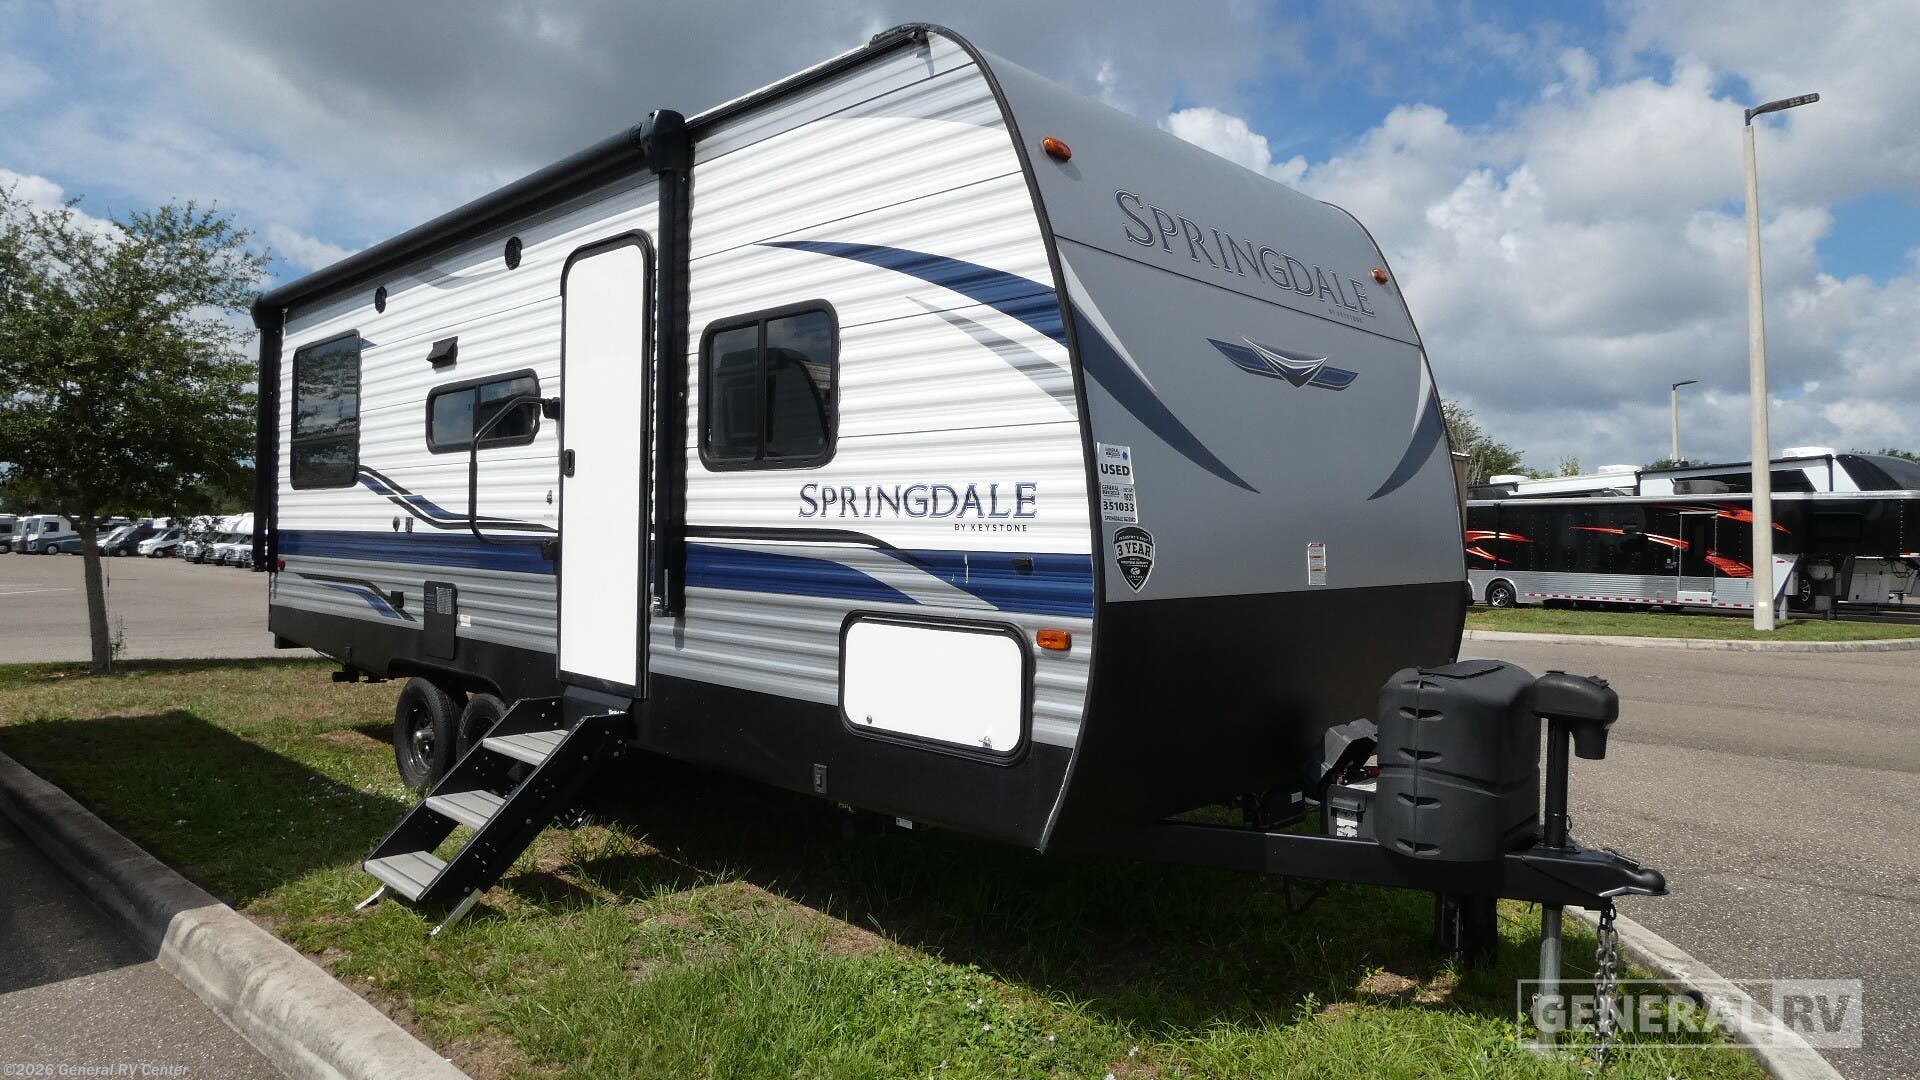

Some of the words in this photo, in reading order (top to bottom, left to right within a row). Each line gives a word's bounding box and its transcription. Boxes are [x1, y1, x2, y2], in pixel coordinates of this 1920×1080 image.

[1115, 189, 1376, 318] SPRINGDALE
[1101, 463, 1130, 476] USED
[798, 481, 1038, 518] SPRINGDALE
[1103, 501, 1135, 512] 351033
[954, 523, 966, 532] BY
[970, 523, 1028, 533] KEYSTONE
[1116, 544, 1123, 557] 3
[1125, 541, 1151, 558] YEAR
